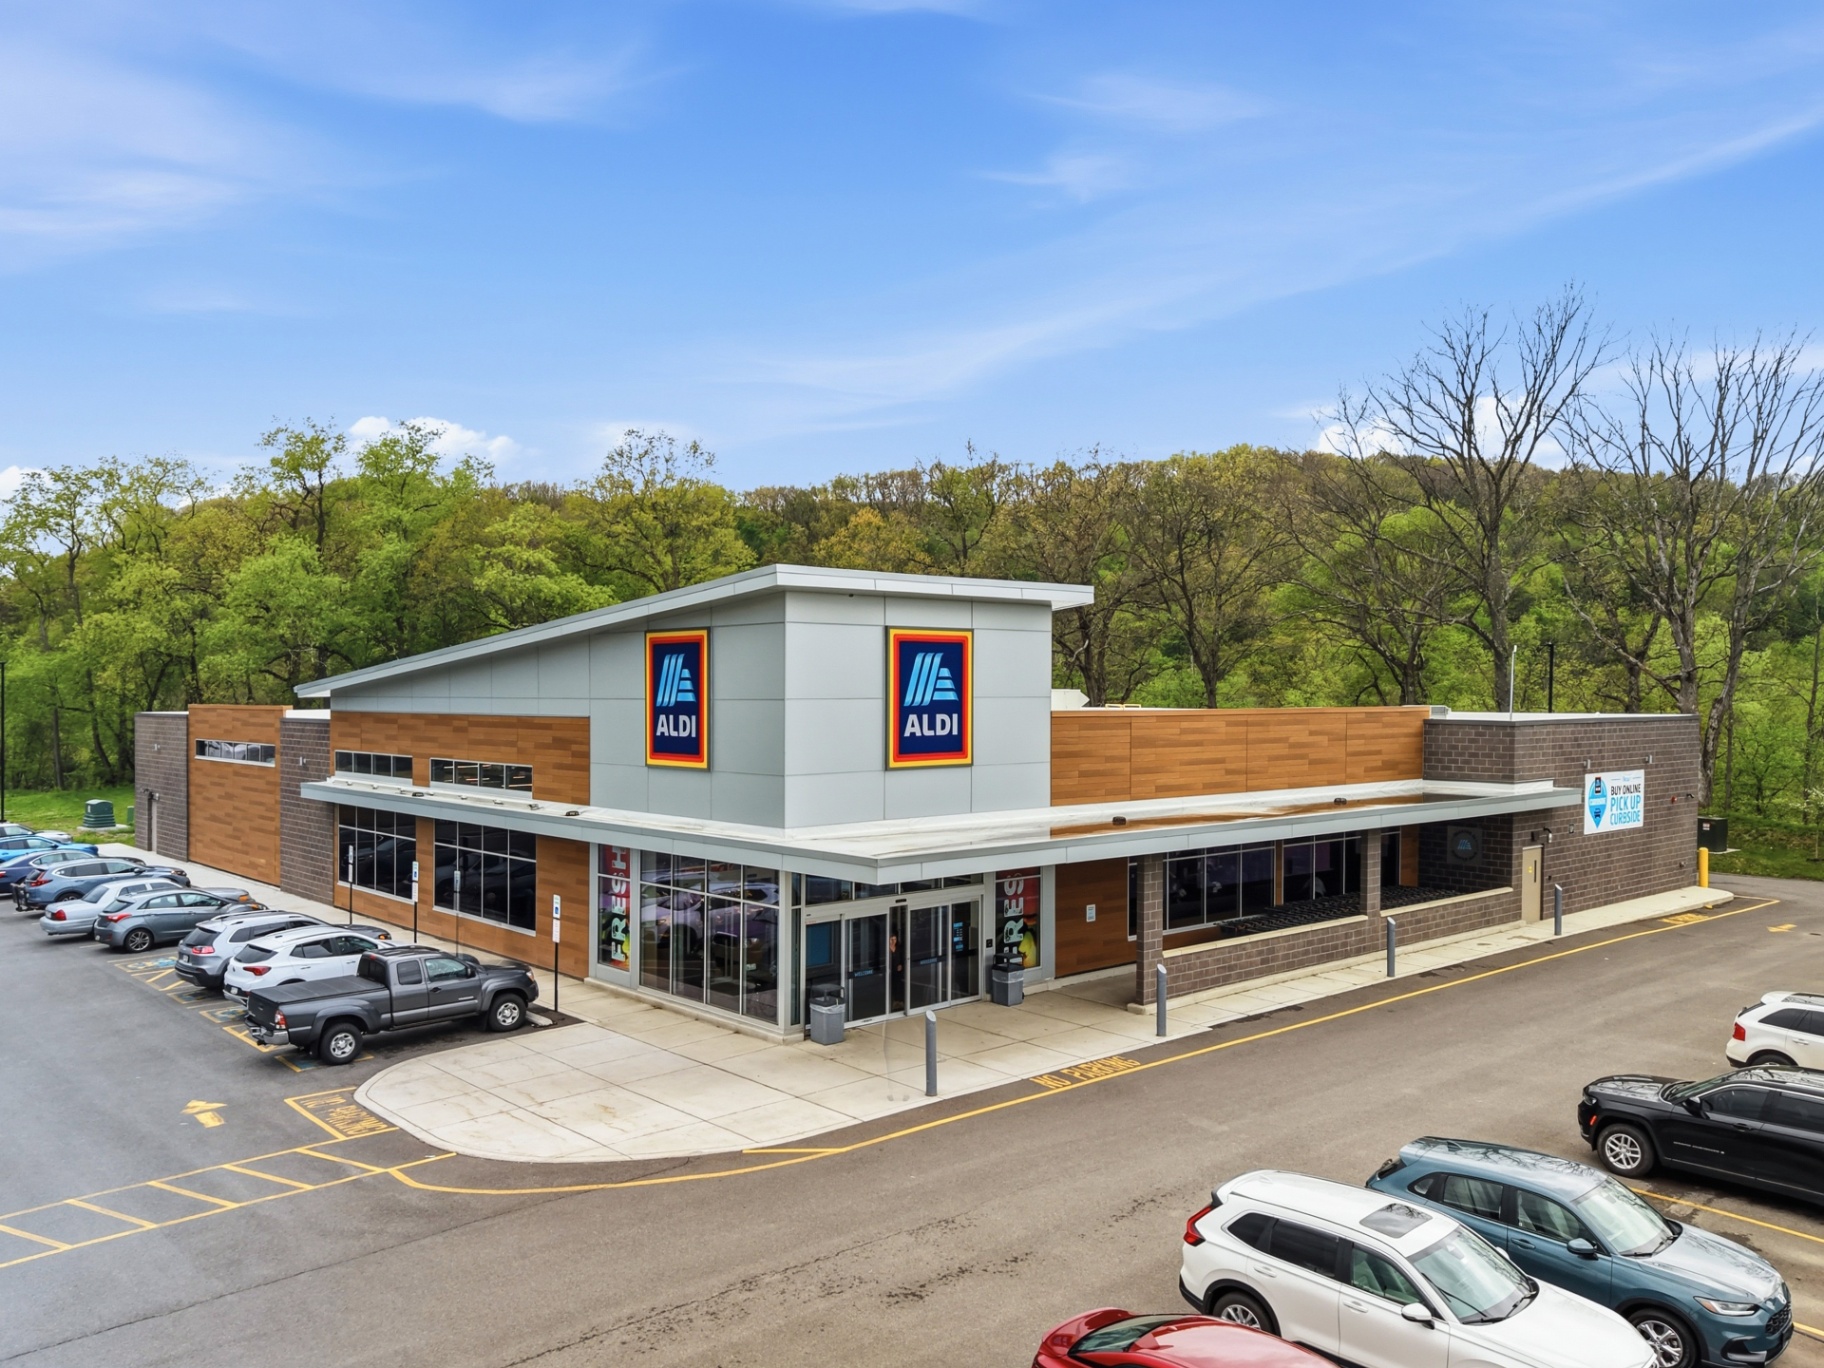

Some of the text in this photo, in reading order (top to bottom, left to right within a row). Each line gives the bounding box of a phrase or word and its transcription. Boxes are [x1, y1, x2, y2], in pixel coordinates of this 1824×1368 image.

[656, 714, 696, 737] ALDI
[904, 713, 959, 737] ALDI
[1610, 785, 1622, 796] BUY
[1622, 783, 1642, 795] ONLINE
[1610, 796, 1629, 812] PICK
[1630, 795, 1641, 810] UP
[1610, 810, 1641, 826] CURBSIDE
[1028, 1055, 1141, 1089] NO PARKING
